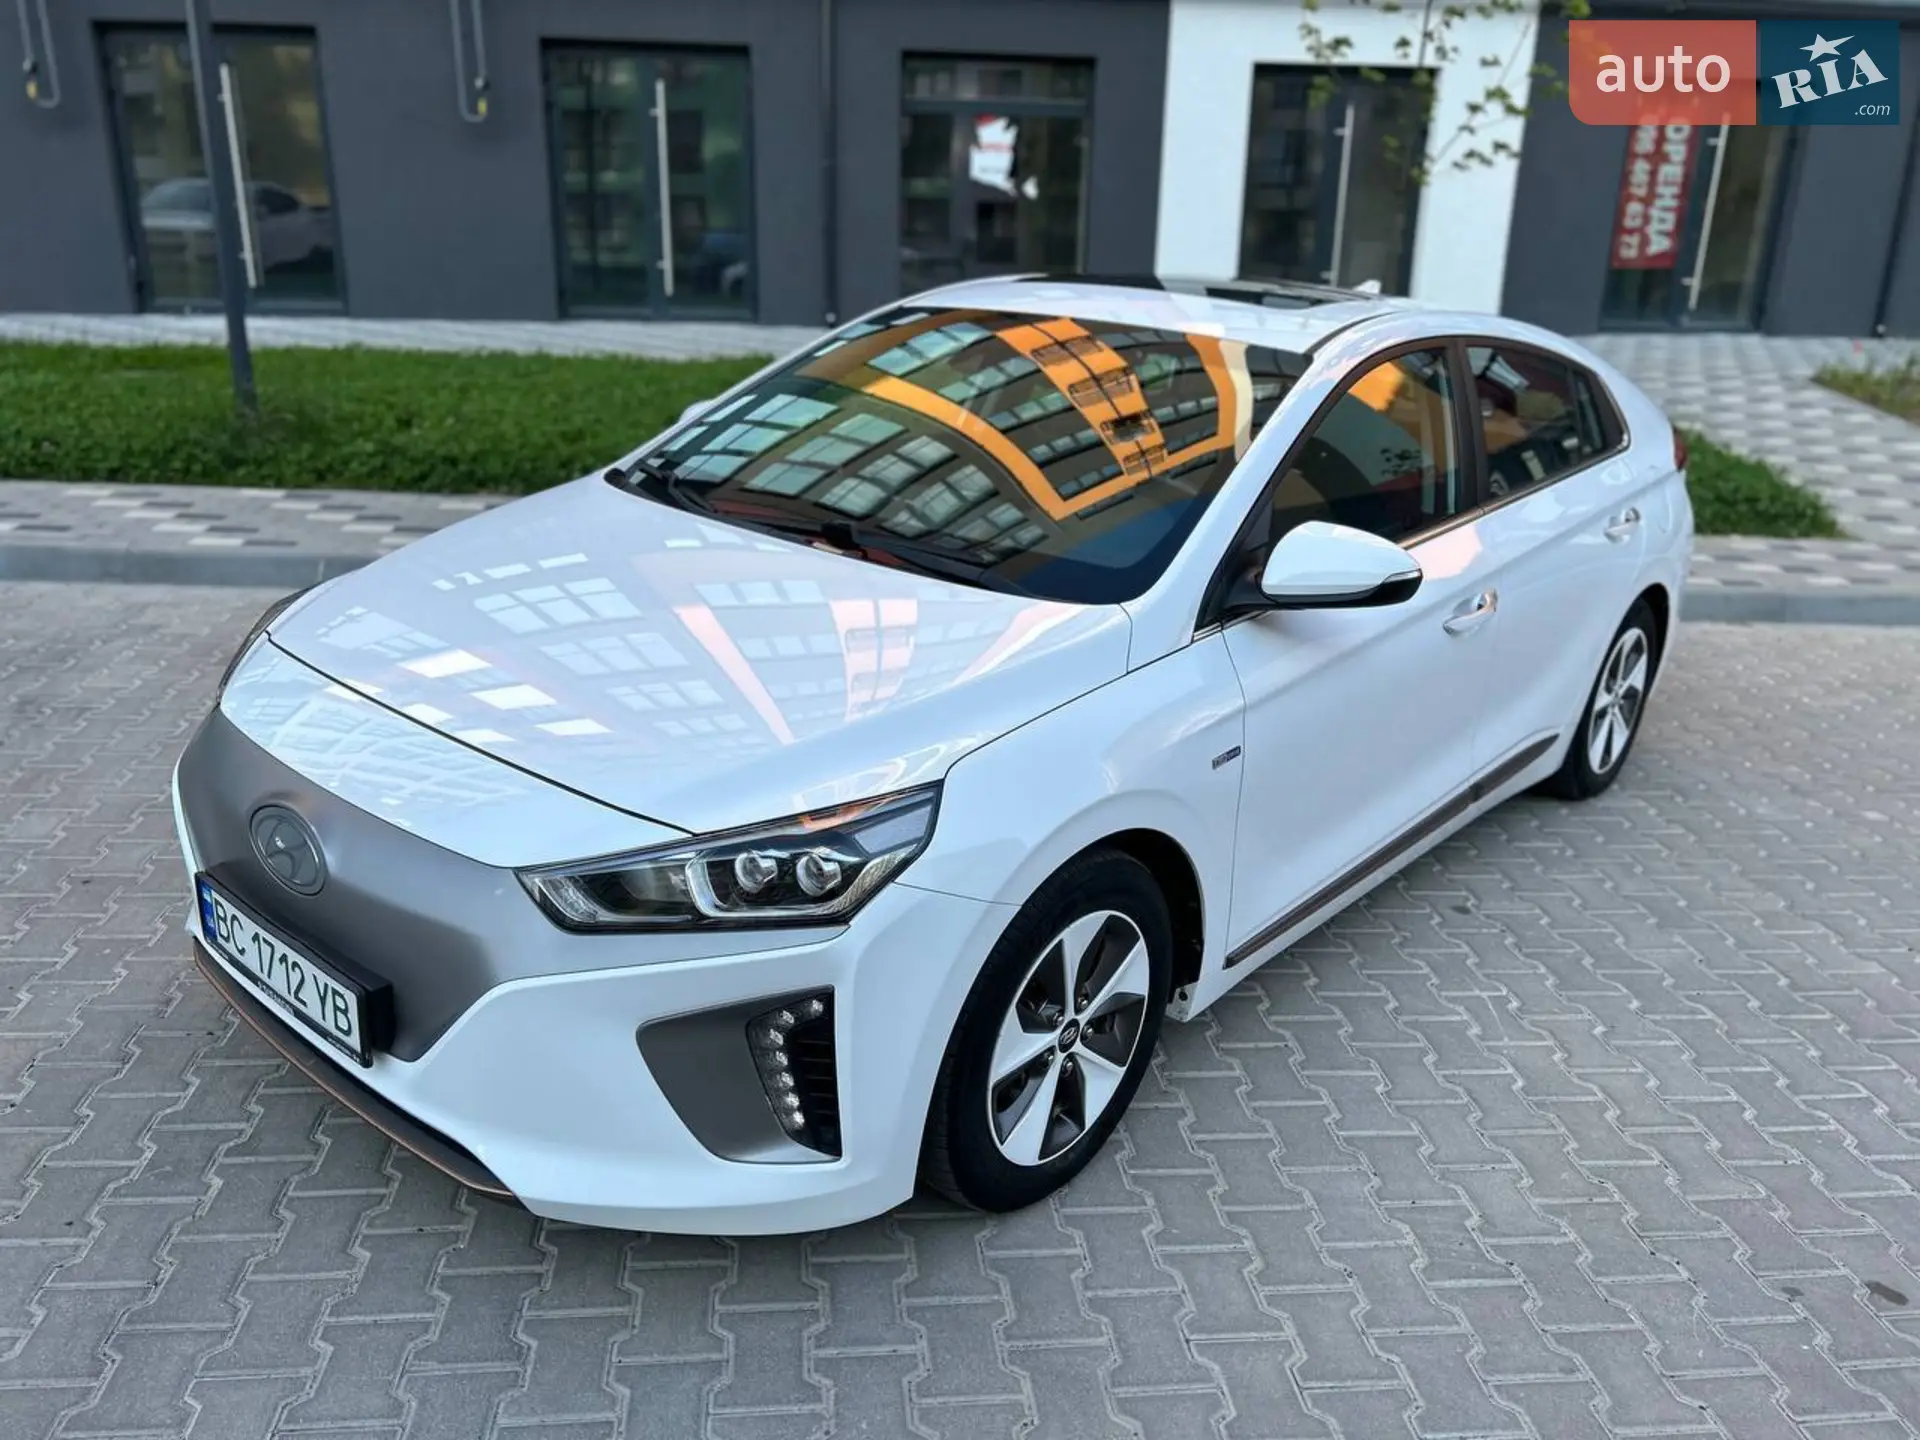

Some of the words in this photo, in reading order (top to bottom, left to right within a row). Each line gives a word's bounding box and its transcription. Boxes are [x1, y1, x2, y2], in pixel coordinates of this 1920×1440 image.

[214, 897, 246, 957] BC
[251, 932, 308, 1009] 1712
[312, 973, 352, 1037] YB
